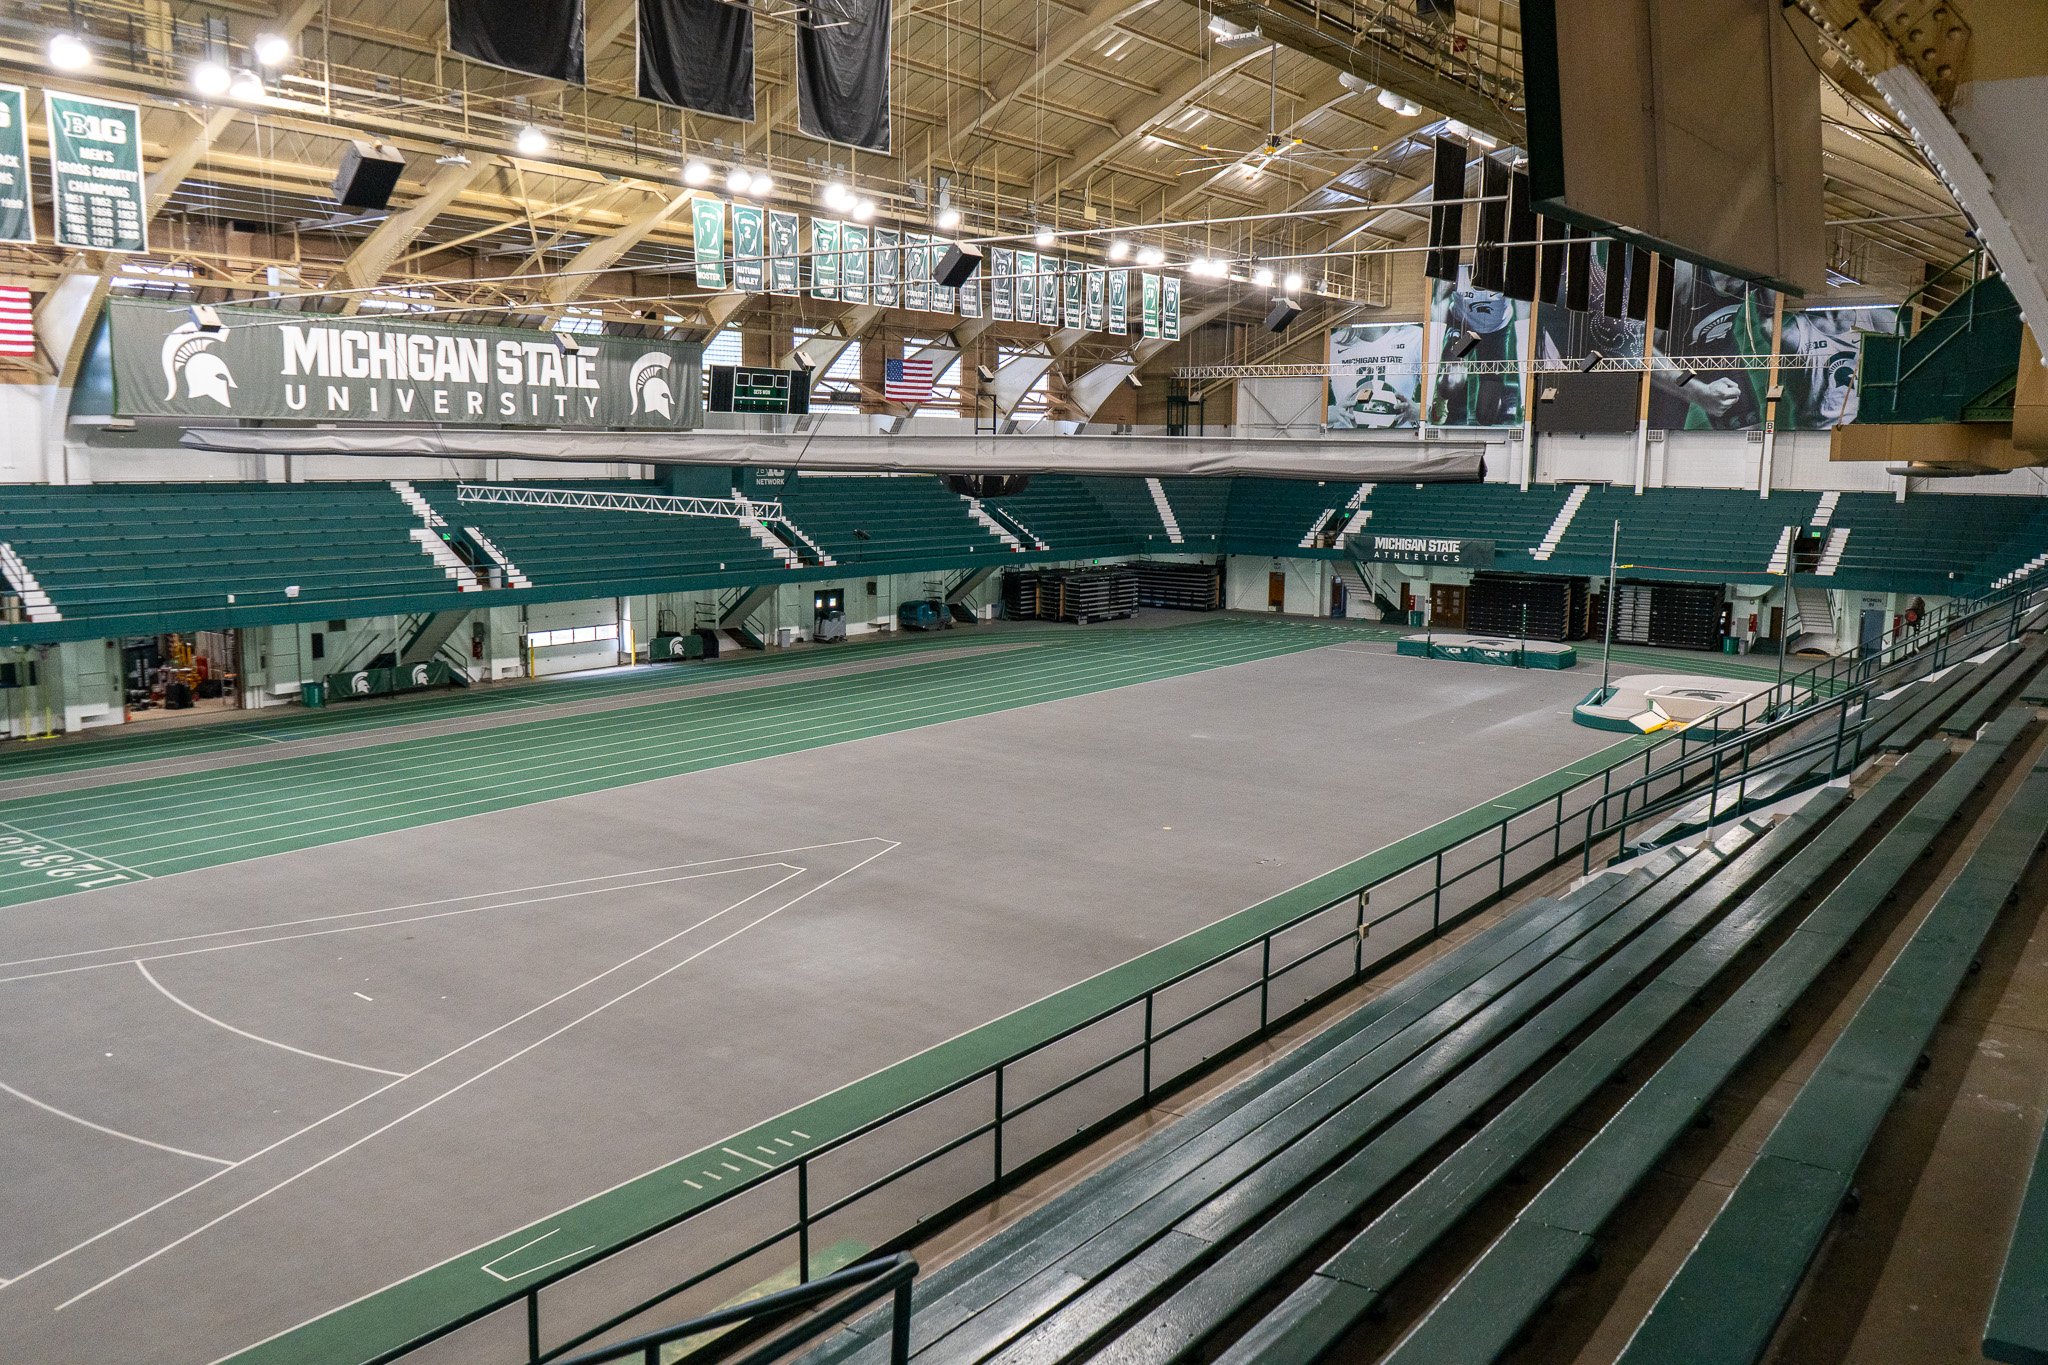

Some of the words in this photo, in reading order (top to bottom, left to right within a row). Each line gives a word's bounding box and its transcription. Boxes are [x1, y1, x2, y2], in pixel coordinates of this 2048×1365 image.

[79, 147, 115, 163] MEN'S
[57, 161, 92, 176] CROSS
[92, 165, 138, 183] COUNTRY
[68, 180, 130, 199] CHAMPIONS
[704, 219, 711, 233] 1
[744, 225, 751, 239] 2
[781, 233, 788, 246] 5
[737, 266, 761, 276] AUTUMN
[998, 264, 1006, 275] 12
[739, 276, 759, 286] BAILEY
[1069, 276, 1077, 287] 15
[278, 325, 489, 384] MICHIGAN
[496, 339, 600, 389] STATE
[1341, 356, 1379, 364] MICHIGAN
[1380, 355, 1403, 363] STATE
[285, 384, 598, 417] UNIVERSITY
[756, 478, 785, 486] NETWORK
[1374, 537, 1426, 552] MICHIGAN
[1428, 540, 1461, 553] STATE
[1374, 551, 1460, 562] ATHLETICS
